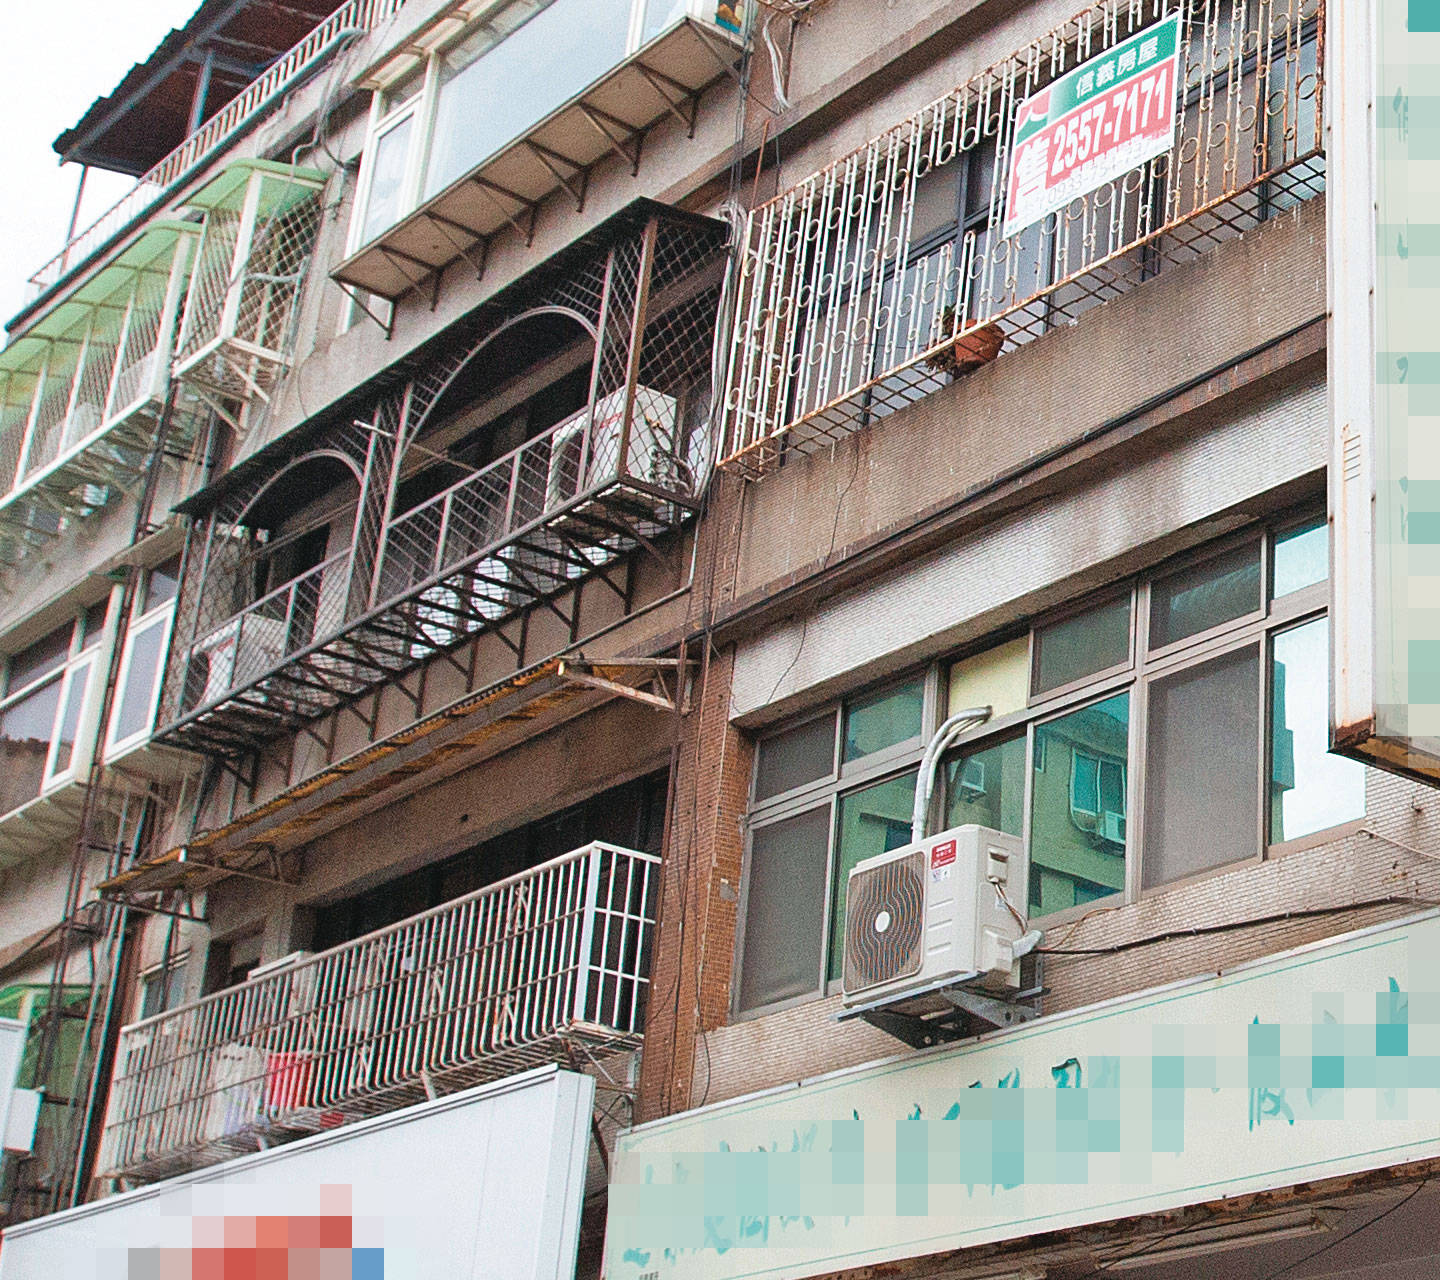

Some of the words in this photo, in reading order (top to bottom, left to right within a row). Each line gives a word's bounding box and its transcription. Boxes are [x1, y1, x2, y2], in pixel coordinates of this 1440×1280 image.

[1076, 36, 1158, 98] 信義房屋
[1051, 68, 1168, 177] 2557-7171
